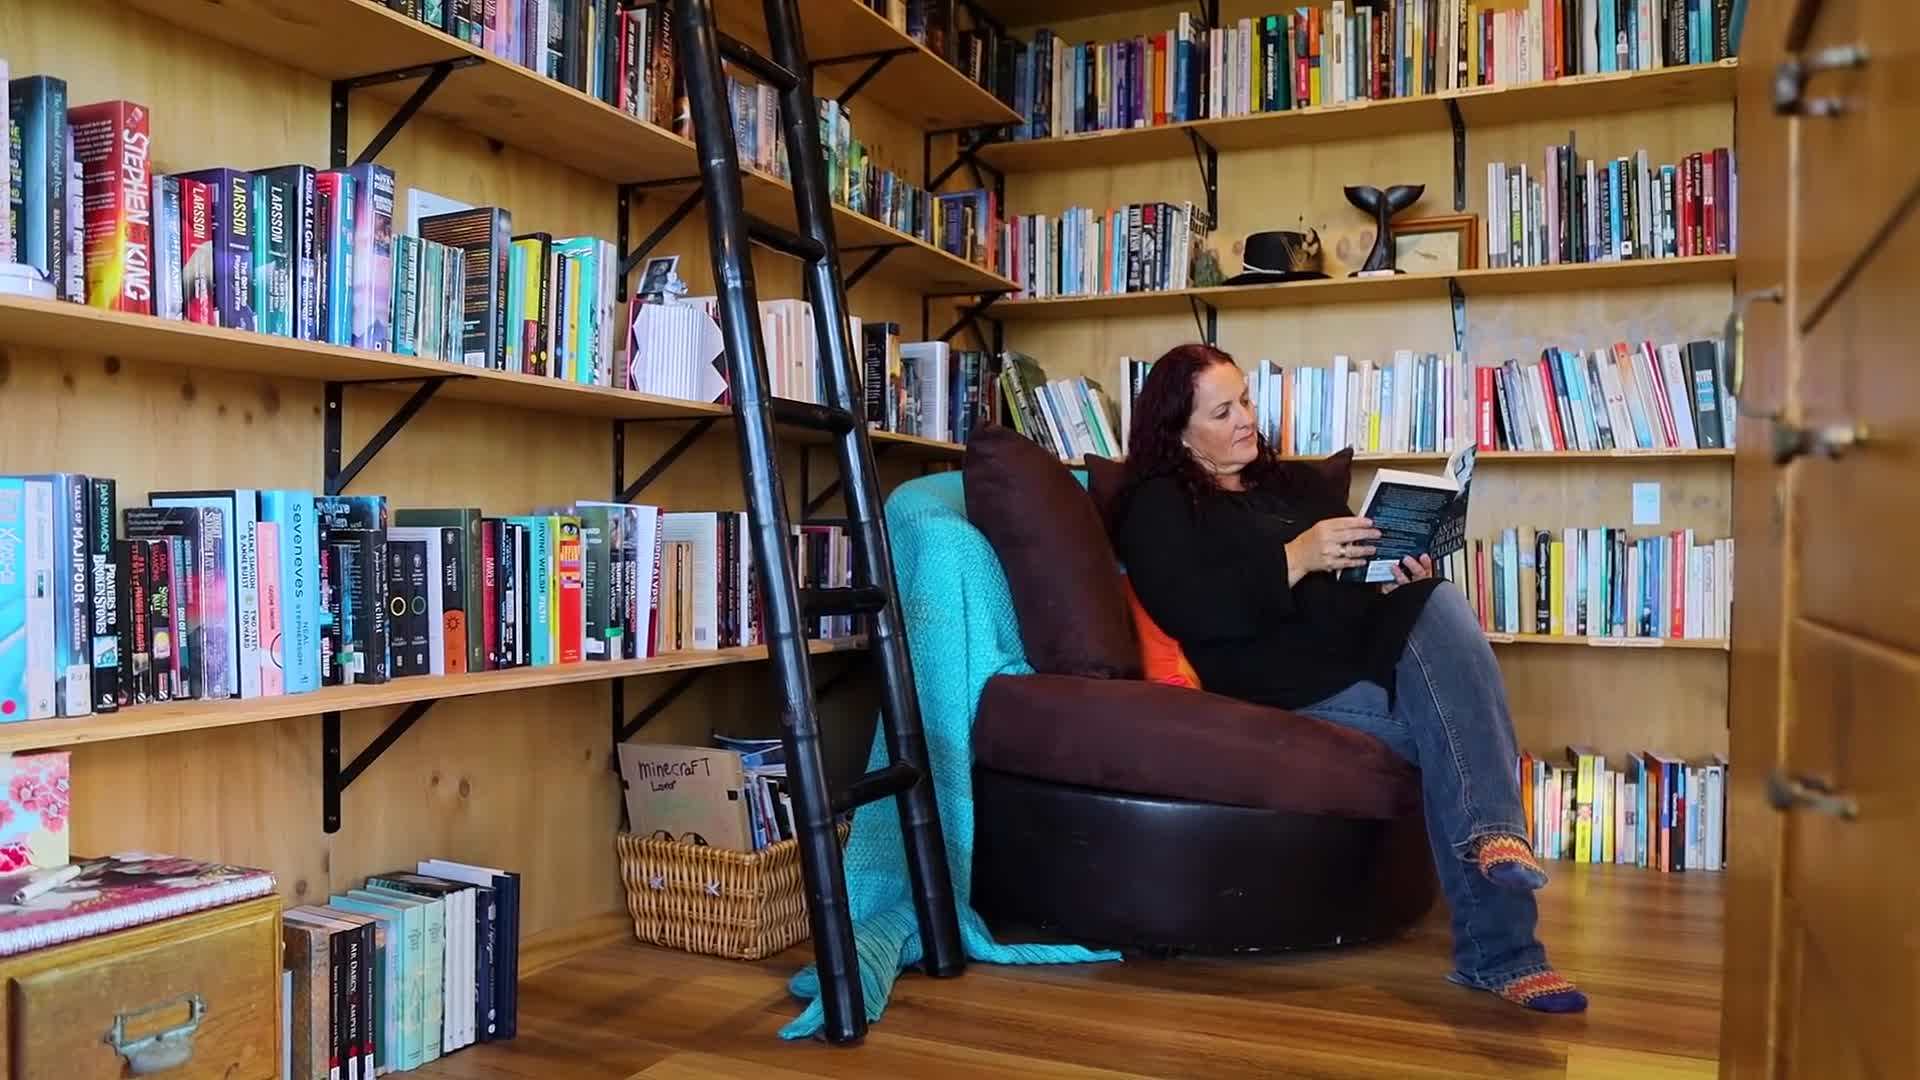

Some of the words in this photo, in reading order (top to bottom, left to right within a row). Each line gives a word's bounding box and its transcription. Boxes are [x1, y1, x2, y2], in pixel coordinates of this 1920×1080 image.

[122, 129, 149, 226] STEPHEN
[305, 173, 314, 206] URSULA
[53, 208, 61, 236] BRIAN
[192, 187, 206, 239] LARSSON
[232, 177, 247, 236] LARSSON
[271, 186, 284, 243] LARSSON
[304, 230, 314, 255] GUIN
[124, 241, 150, 302] KING
[74, 484, 82, 512] TALES
[100, 483, 109, 507] DAN
[100, 506, 109, 553] SIMMONS
[538, 522, 546, 556] IRVINE
[73, 527, 86, 604] MAJIPOOR
[248, 551, 257, 590] SIMSION
[292, 503, 306, 599] seveneves
[92, 555, 106, 597] BROKEN
[105, 563, 117, 610] PRAYERS
[241, 564, 250, 590] BUIST
[538, 557, 546, 594] WELSH
[93, 596, 107, 635] STONES
[152, 594, 162, 611] KALI
[160, 586, 169, 607] SONG
[107, 611, 117, 626] TO
[243, 610, 252, 649] FORWARD
[249, 609, 257, 626] TWO
